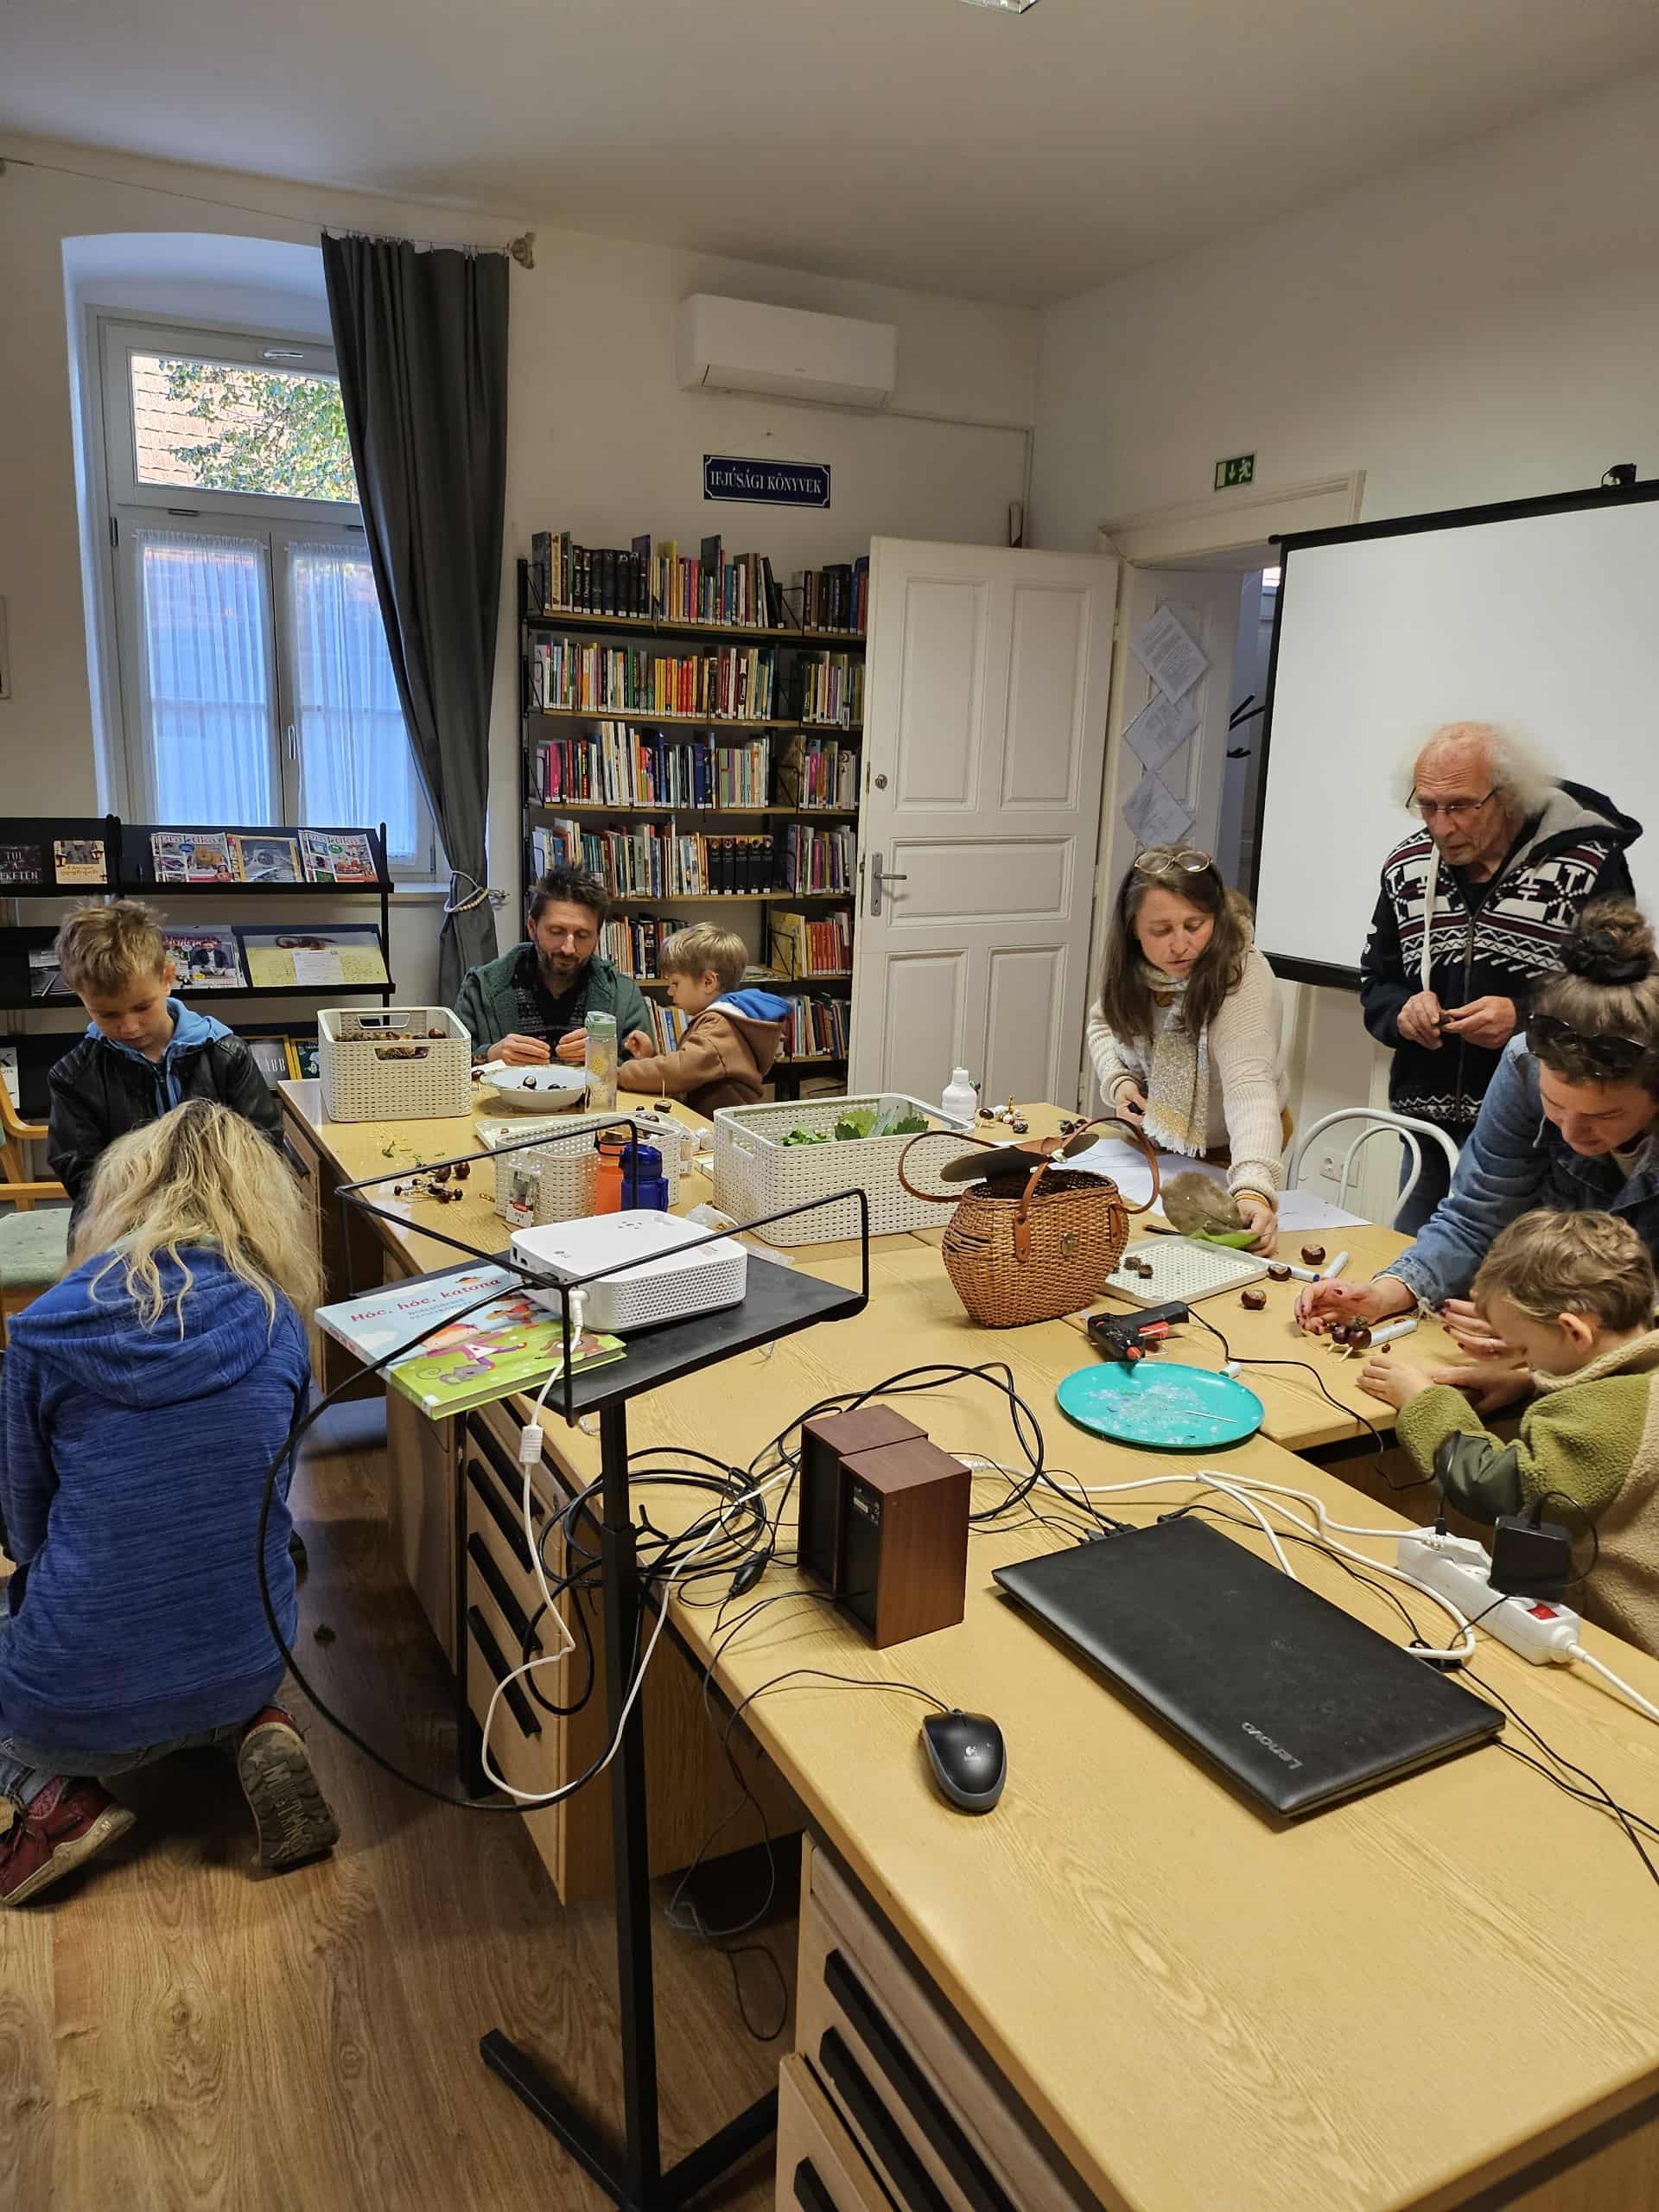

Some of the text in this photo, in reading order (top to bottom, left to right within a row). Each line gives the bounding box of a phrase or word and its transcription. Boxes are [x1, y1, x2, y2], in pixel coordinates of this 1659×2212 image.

[711, 467, 822, 493] IFJÚSÁGI KÖNYVEK
[441, 1278, 501, 1299] katona
[1241, 1721, 1304, 1770] Lenovo
